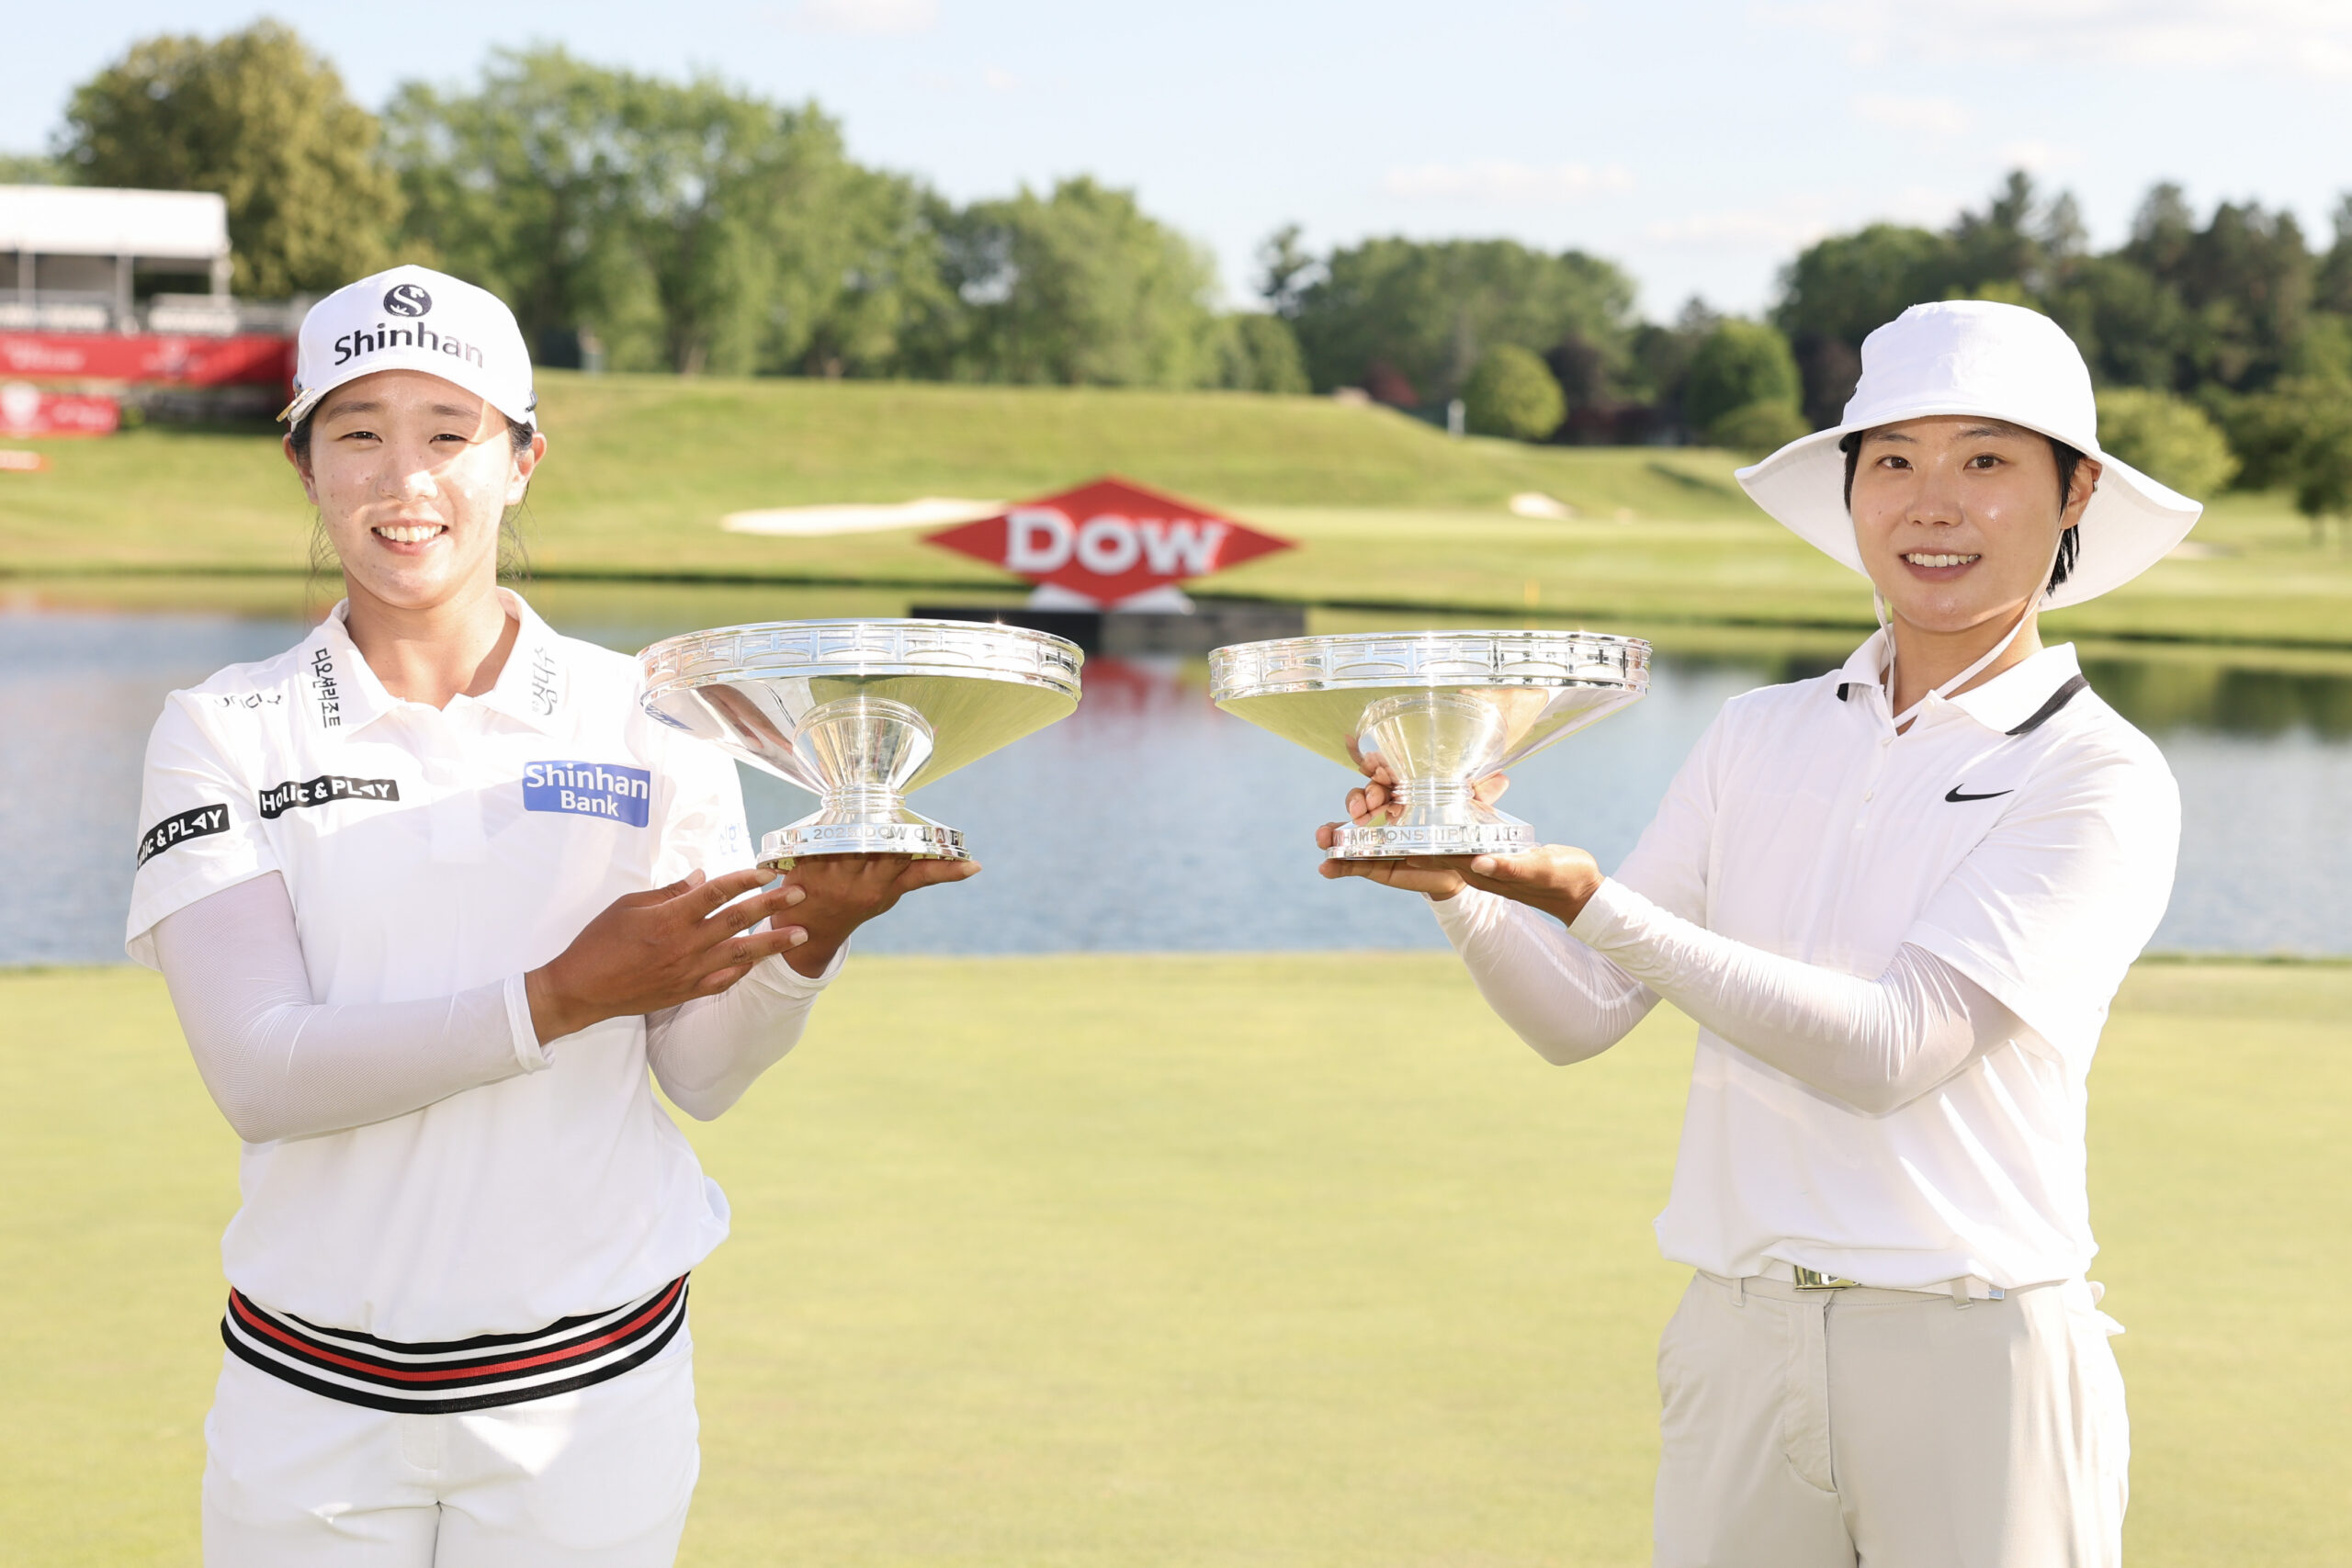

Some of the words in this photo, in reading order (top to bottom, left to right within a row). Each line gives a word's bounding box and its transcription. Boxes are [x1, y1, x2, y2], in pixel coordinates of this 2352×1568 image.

[334, 321, 483, 368] Shinhan
[311, 648, 341, 728] 디오션리조트
[314, 782, 328, 799] &
[332, 780, 390, 798] PLAY
[526, 762, 649, 799] Shinhan
[560, 790, 620, 818] Bank
[156, 829, 167, 848] &
[168, 809, 222, 841] PLAY
[865, 826, 908, 840] DOW
[1336, 829, 1459, 844] HAMPONSHIP
[1462, 827, 1522, 841] WNNER
